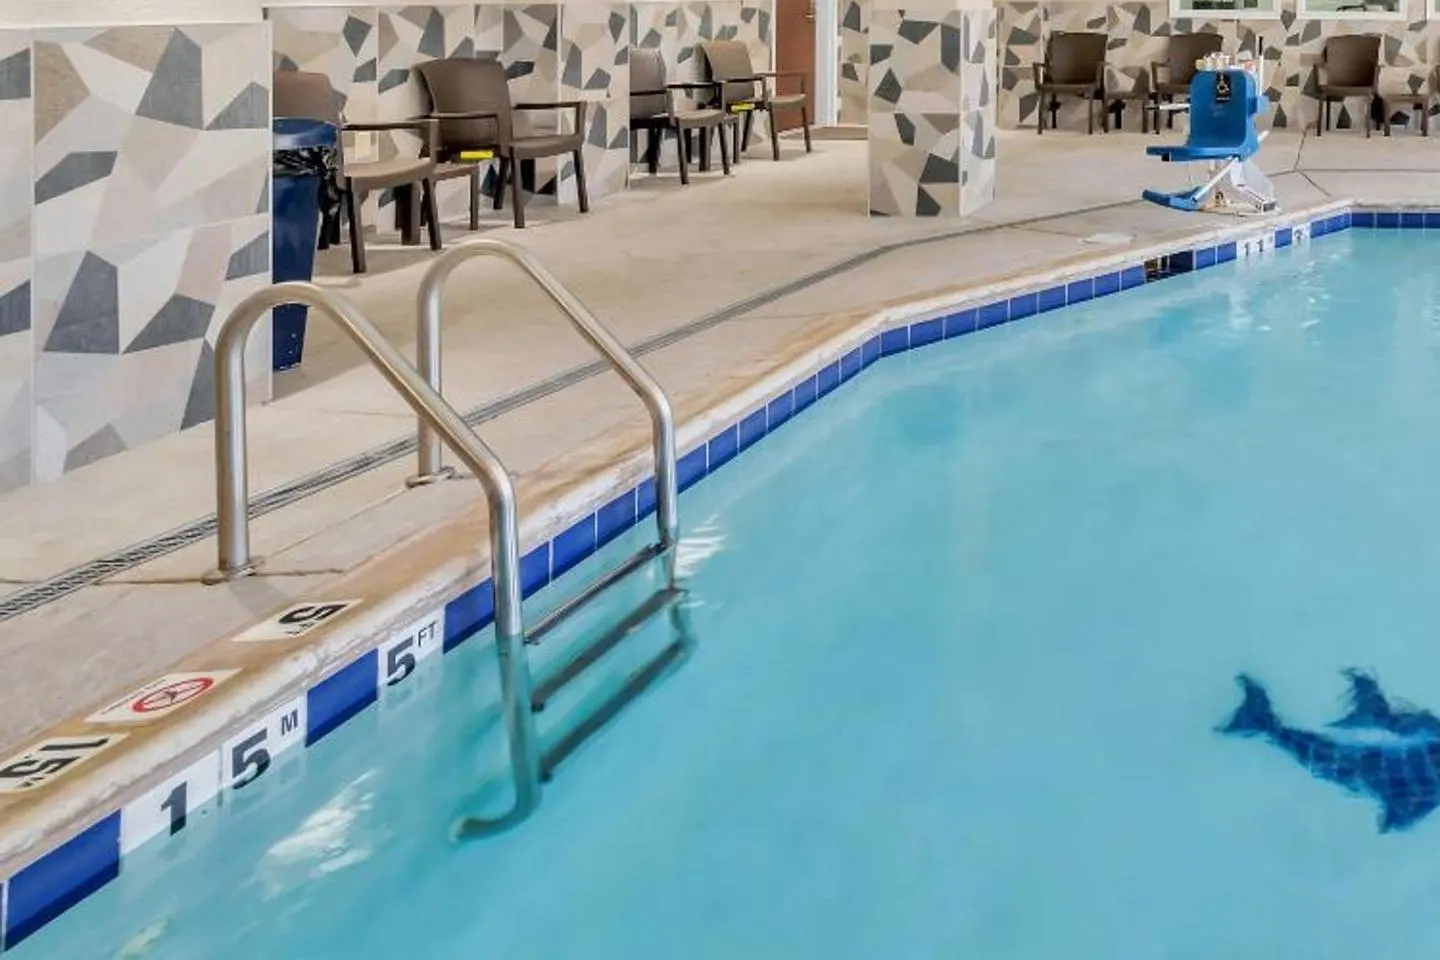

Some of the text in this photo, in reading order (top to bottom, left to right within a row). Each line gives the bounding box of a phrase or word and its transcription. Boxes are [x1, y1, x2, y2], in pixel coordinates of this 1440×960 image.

[279, 604, 350, 624] 5
[387, 620, 438, 686] 5 FT
[281, 709, 298, 736] M
